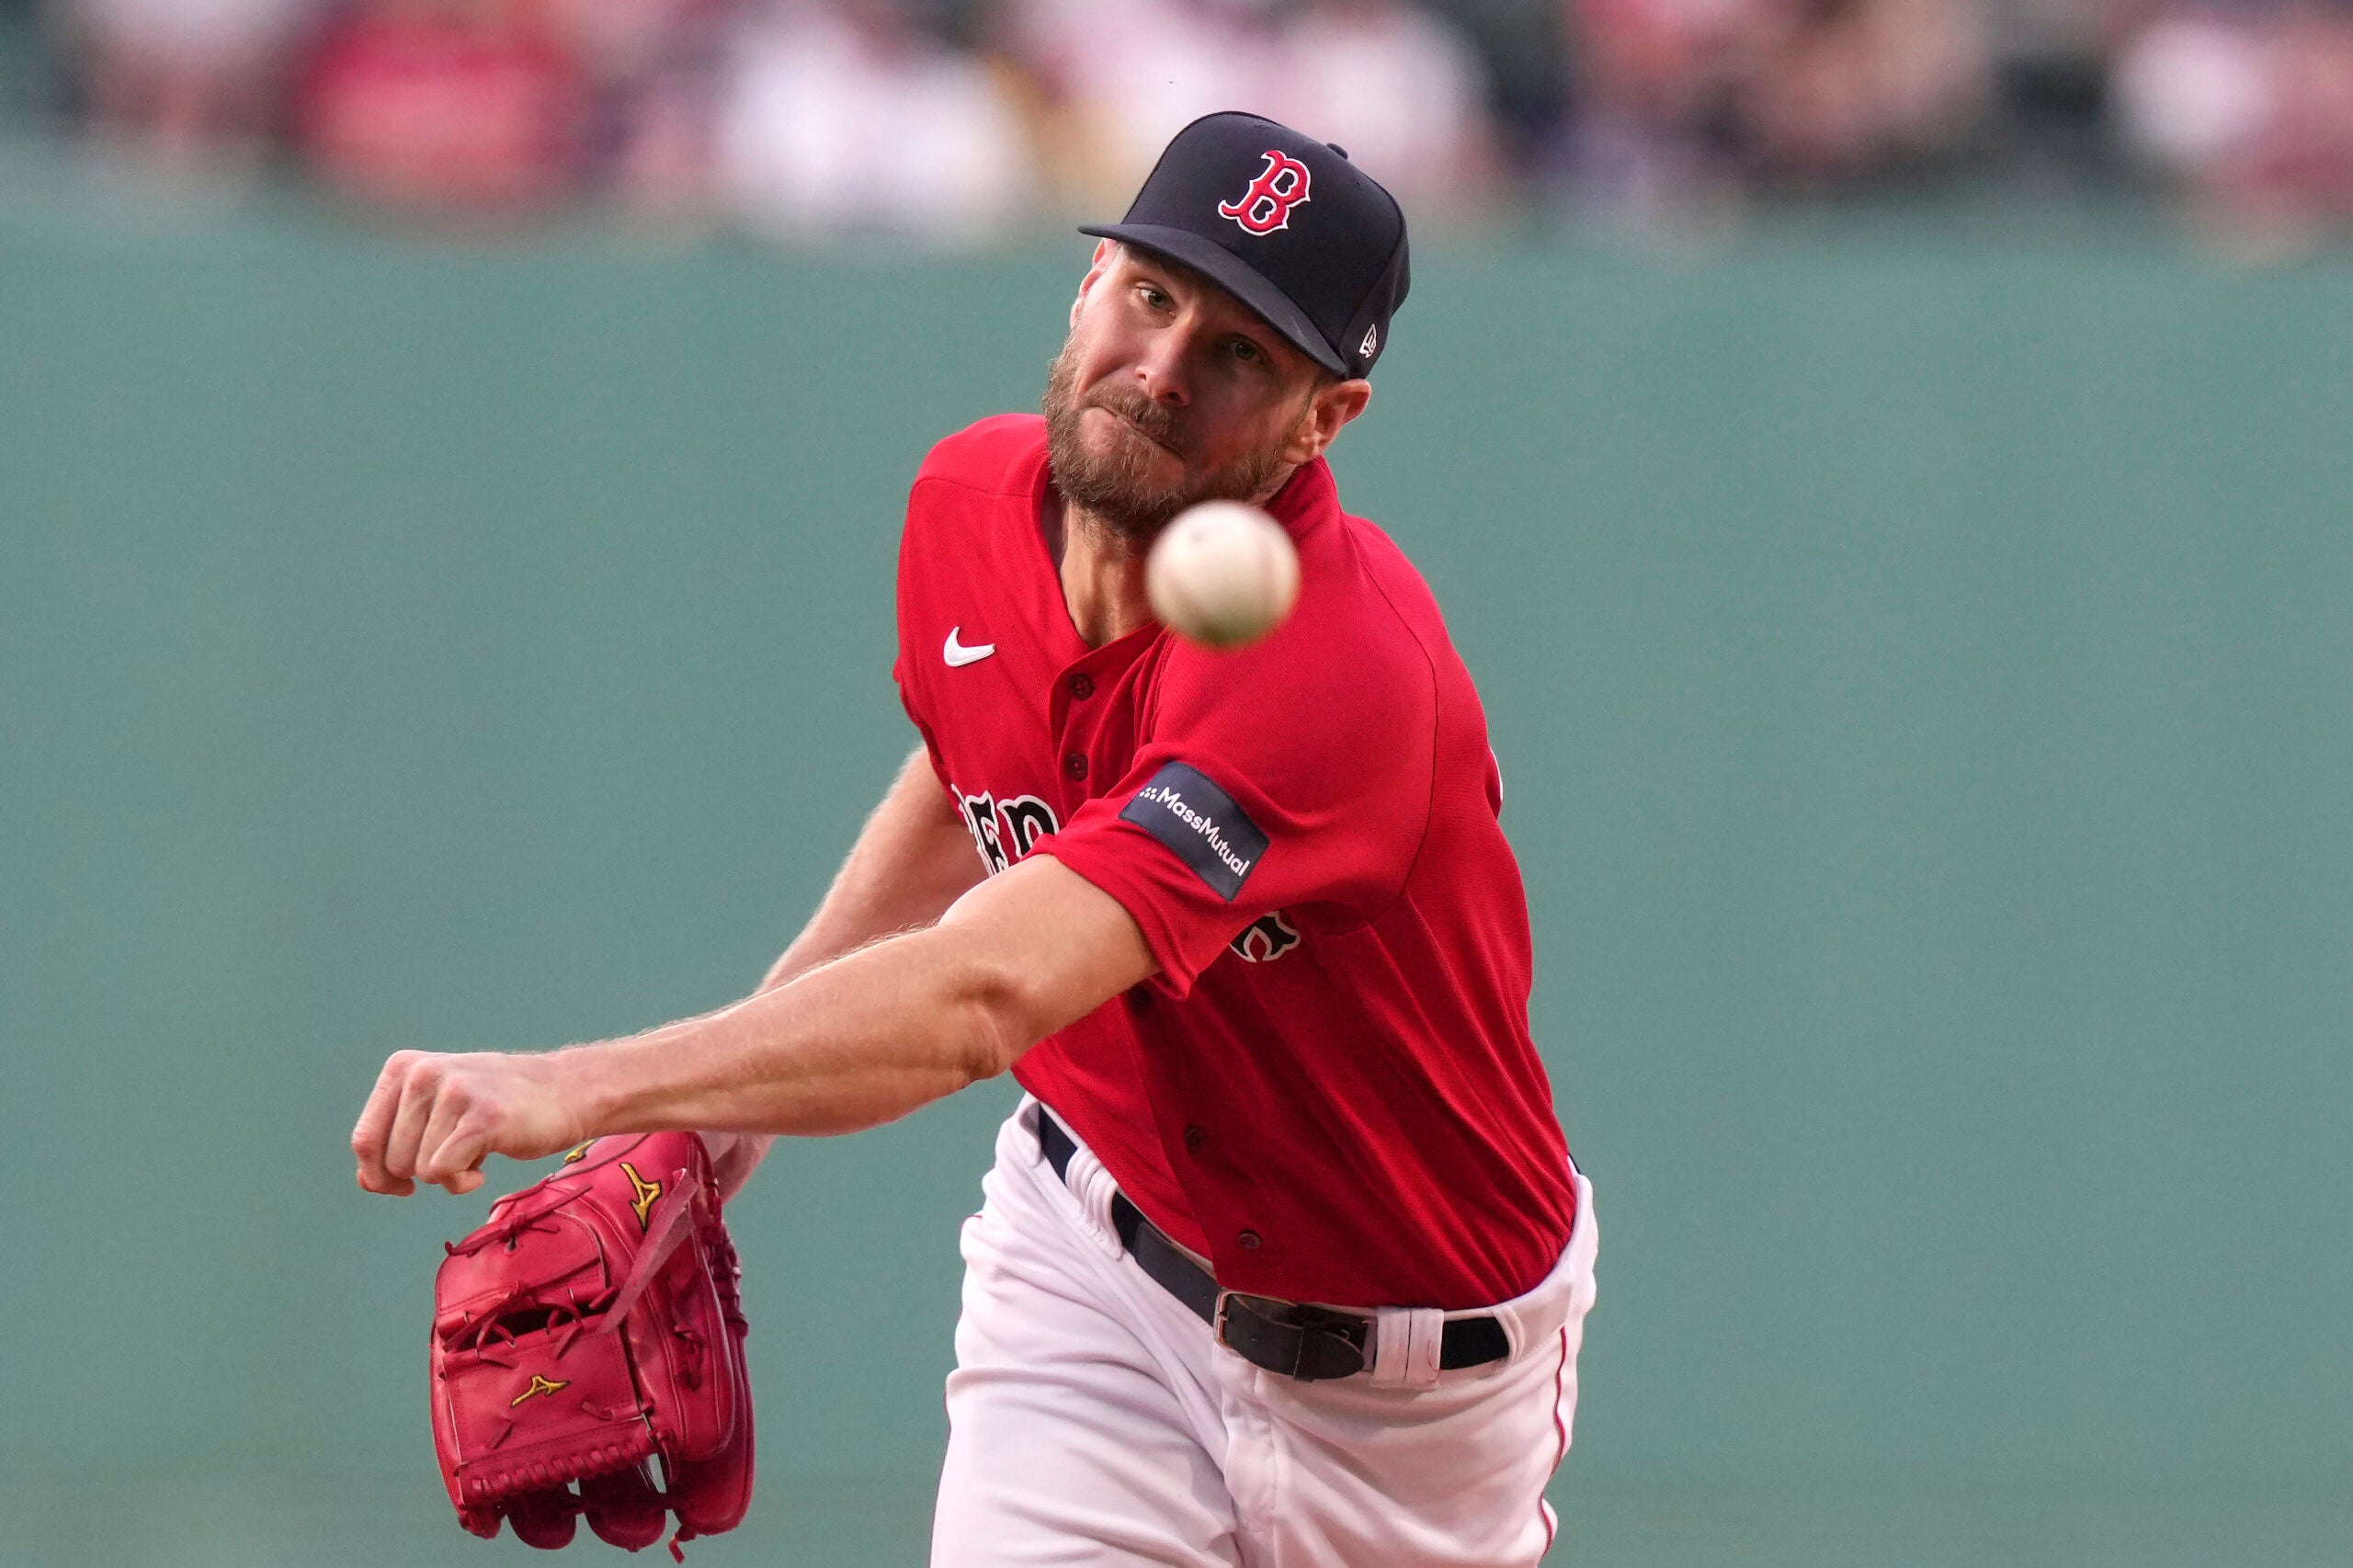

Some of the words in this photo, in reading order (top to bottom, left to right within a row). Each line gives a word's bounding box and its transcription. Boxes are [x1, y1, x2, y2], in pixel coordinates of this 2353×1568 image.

[1218, 150, 1311, 236] B
[951, 783, 1060, 878] ED
[1155, 787, 1250, 877] MassMutual
